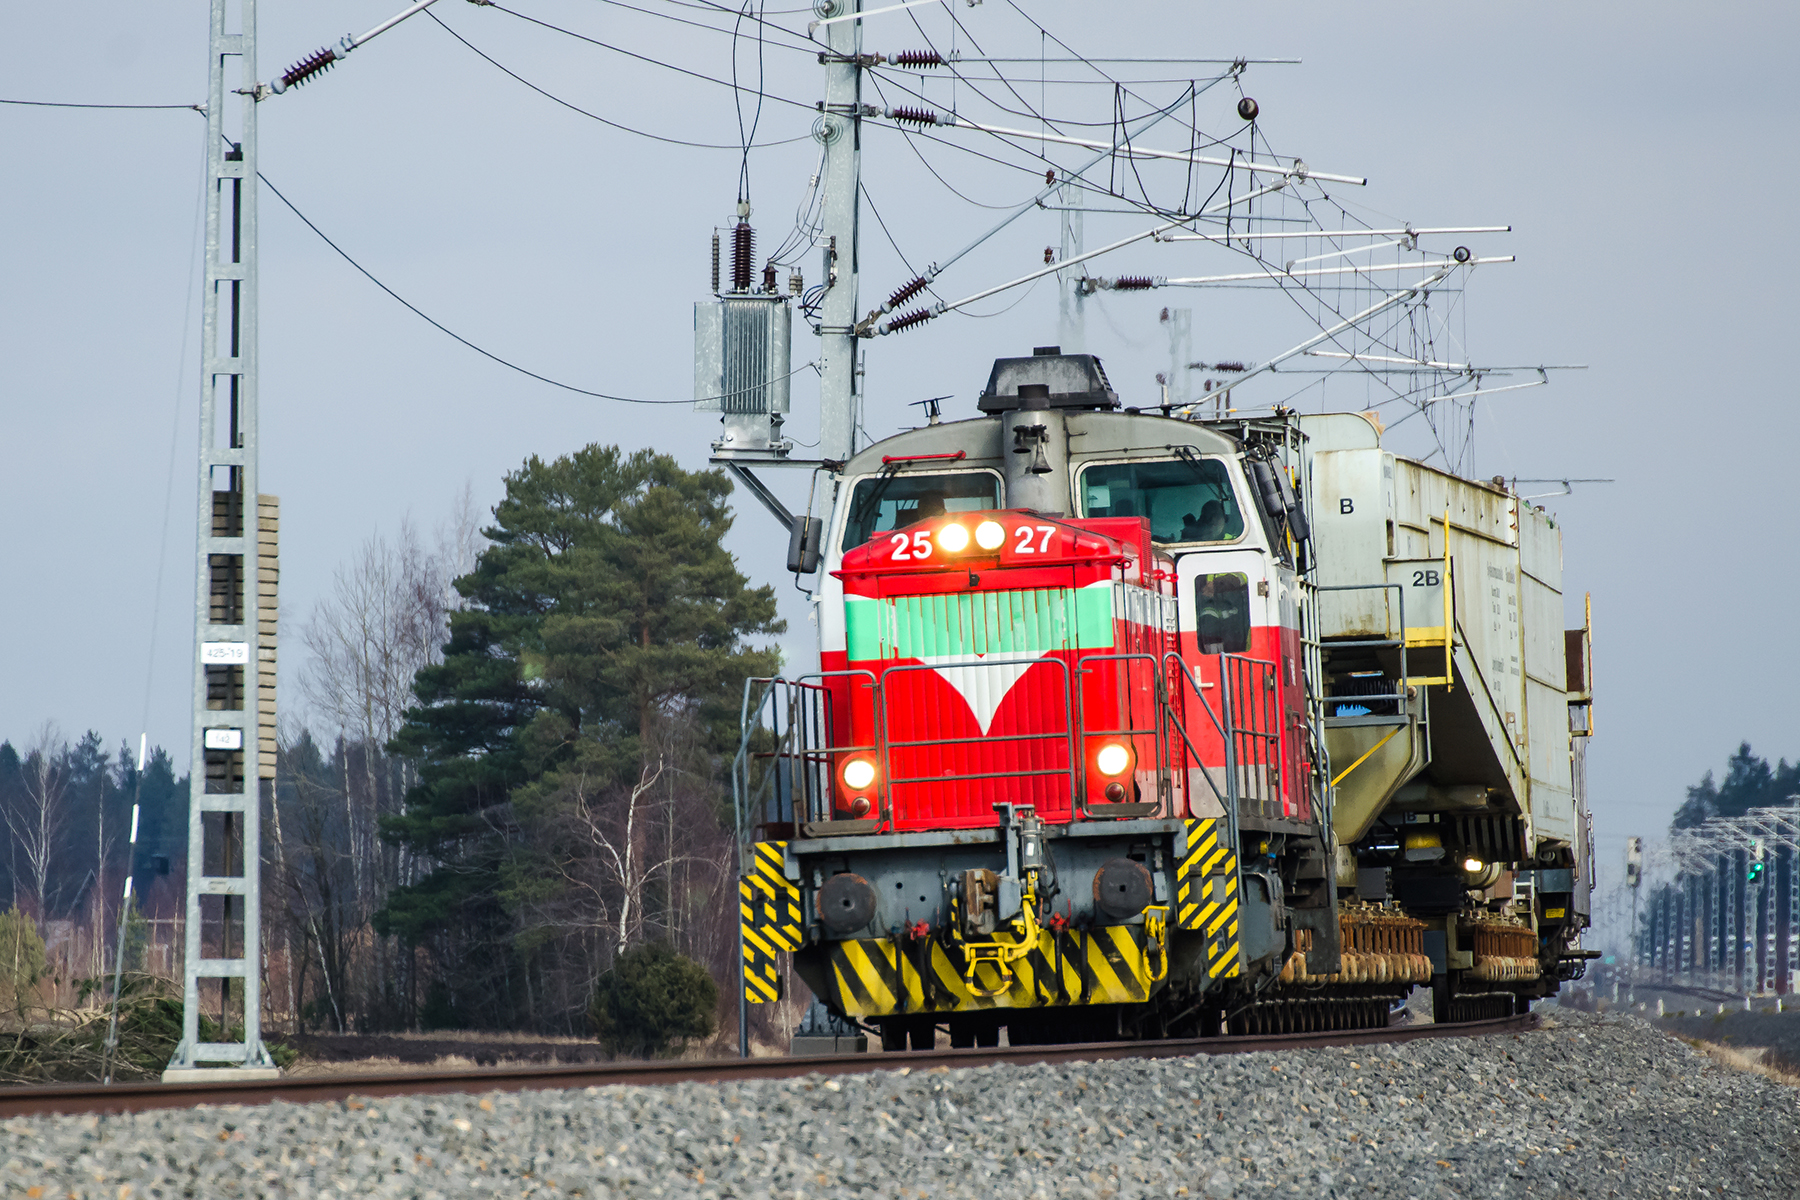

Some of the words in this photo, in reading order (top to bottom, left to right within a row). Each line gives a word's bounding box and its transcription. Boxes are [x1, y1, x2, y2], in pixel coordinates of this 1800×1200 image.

[1339, 498, 1354, 515] B
[890, 530, 934, 561] 25
[1014, 526, 1057, 554] 27
[1412, 570, 1440, 587] 2B
[207, 648, 243, 659] 425-19
